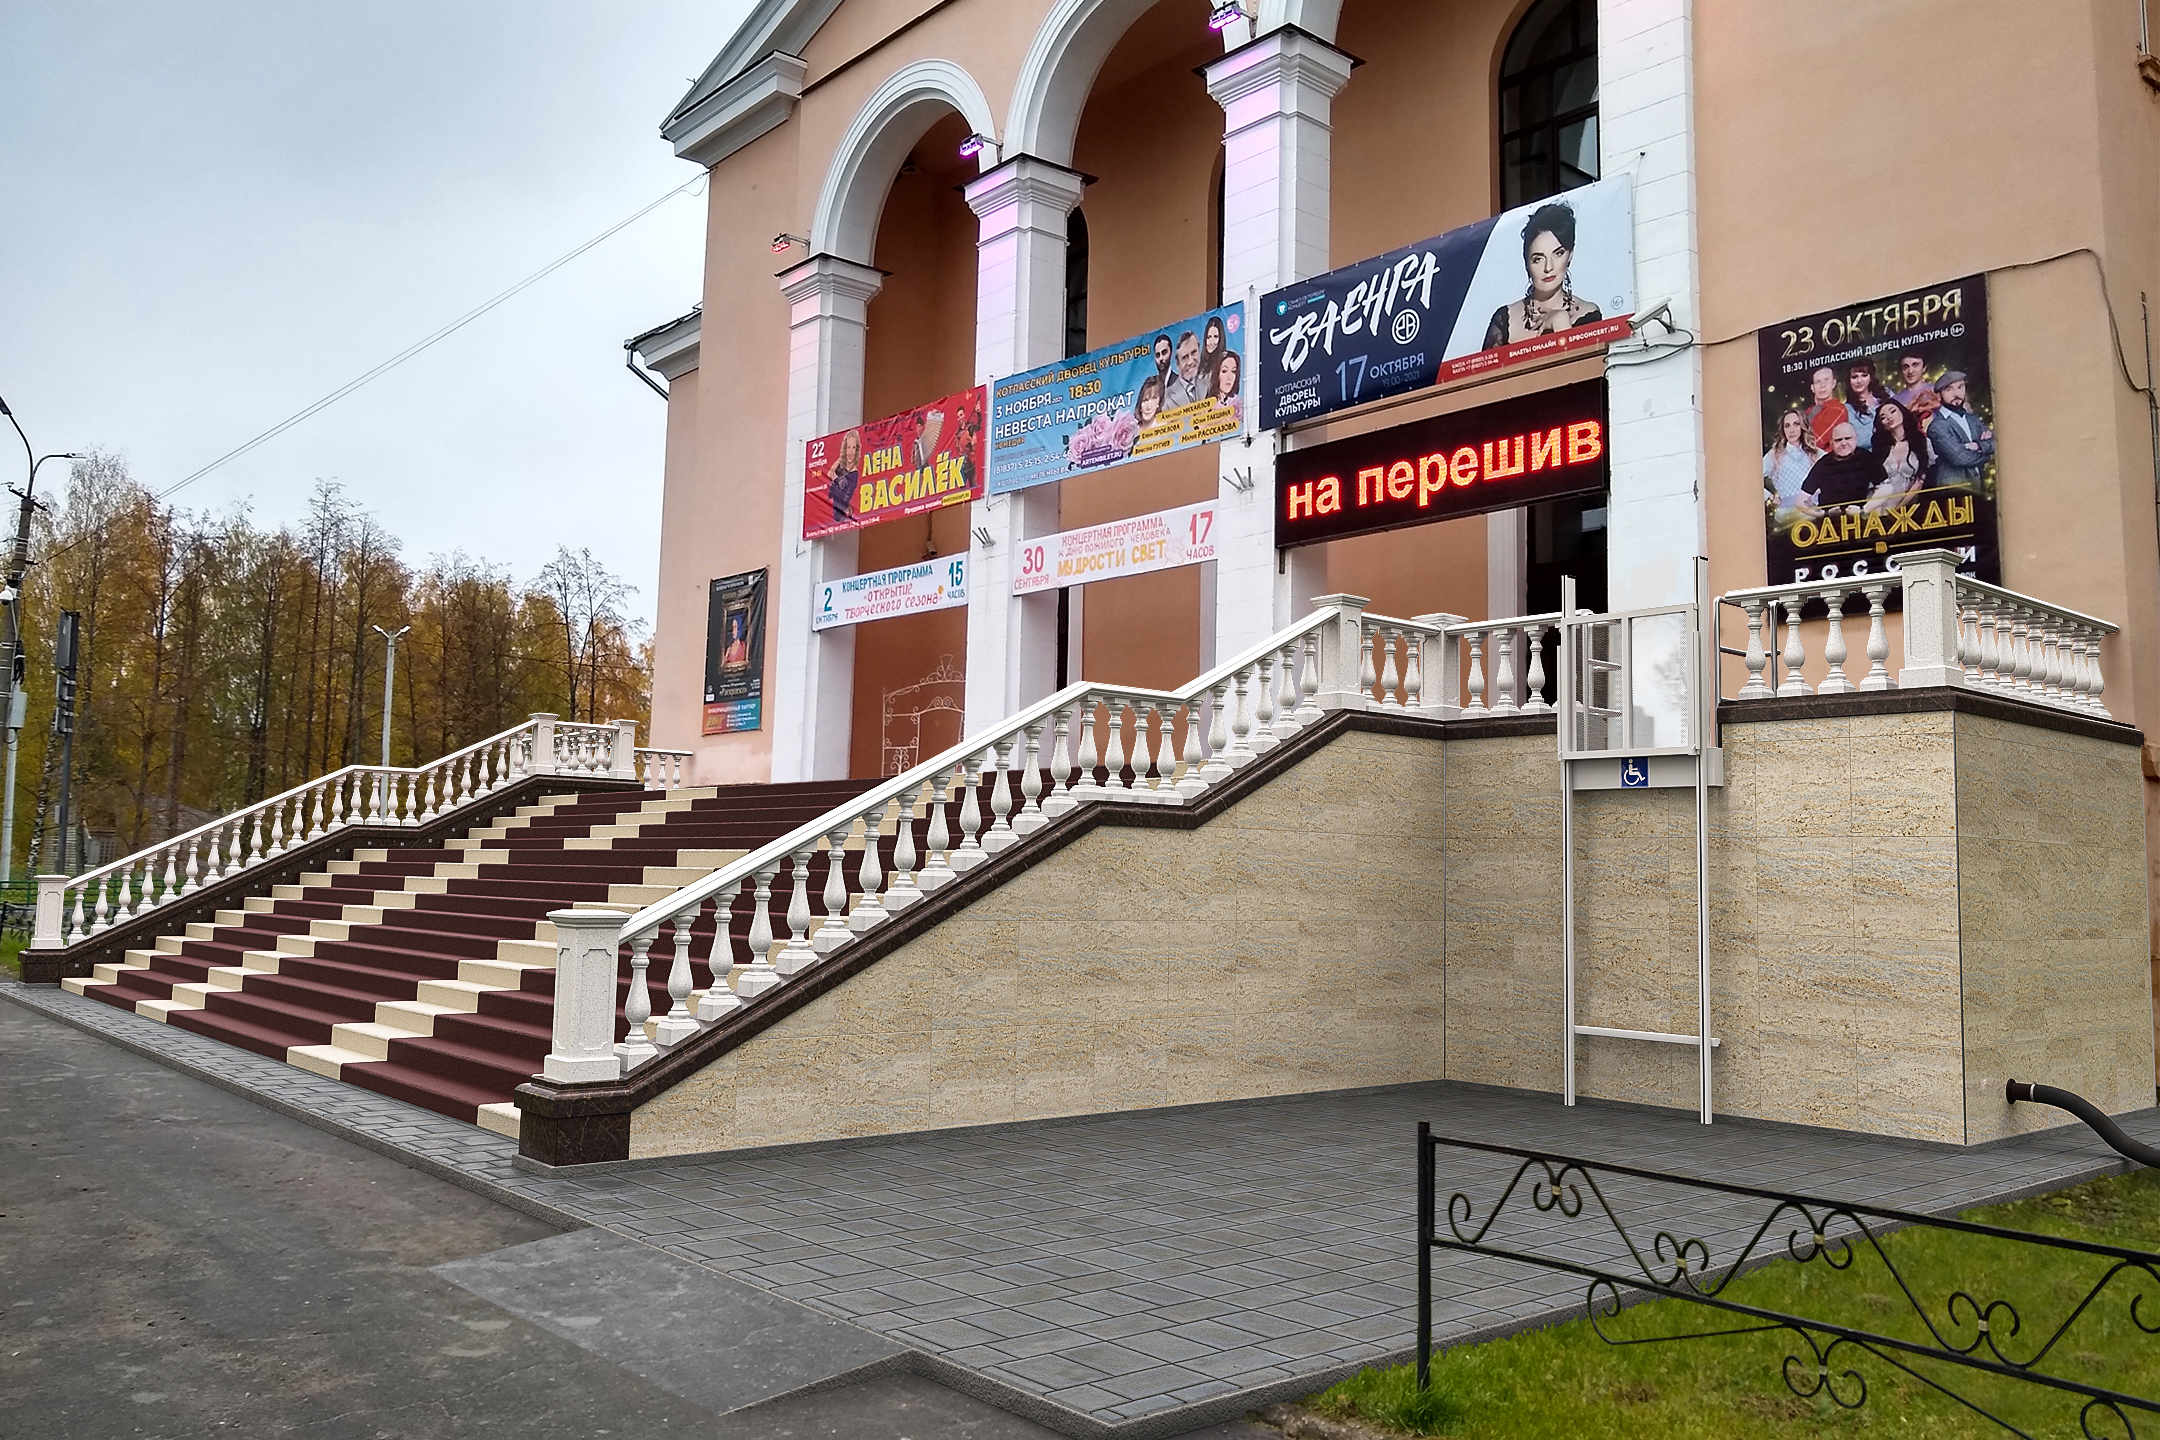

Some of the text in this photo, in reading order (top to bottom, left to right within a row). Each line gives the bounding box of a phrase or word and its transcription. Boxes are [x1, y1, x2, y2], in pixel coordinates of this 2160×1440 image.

[1228, 318, 1240, 329] 6+
[1270, 251, 1440, 373] ВАЕНГА
[1781, 288, 1962, 359] 23 ОКТЯБРЯ
[1568, 325, 1619, 343] SPBCONCERT.RU
[1509, 340, 1557, 358] БИЛЕТЫ ОНЛАЙН
[1782, 362, 1803, 374] 18:30
[1809, 346, 1862, 368] КОТЛАССКИЙ
[1864, 340, 1900, 356] ДВОРЕЦ
[1902, 328, 1949, 346] КУЛЬТУРЫ
[996, 344, 1151, 399] КОТЛАССКИЙ ДВОРЕЦ КУЛЬТУРЫ
[1336, 352, 1424, 401] 17 ОКТЯБРЯ
[1275, 374, 1321, 396] КОТЛАССКИЙ
[1279, 387, 1316, 407] ДВОРЕЦ
[996, 406, 1003, 419] 3
[1005, 392, 1052, 416] НОЯБРЯ
[1068, 380, 1102, 400] 18:30
[1183, 401, 1211, 415] МИХАЙЛОВ
[1275, 397, 1321, 419] КУЛЬТУРЫ
[995, 391, 1135, 440] НЕВЕСТА НАПРОКАТ
[1207, 409, 1231, 421] ТАКШИНА
[1154, 424, 1180, 437] ПРОКЛОВА
[1198, 422, 1237, 438] РАССКАЗОВА
[812, 442, 825, 459] 22
[995, 436, 1026, 450] КОМЕДИЯ
[809, 458, 828, 469] октября
[862, 446, 903, 477] ЛЕНА
[1289, 420, 1602, 520] на перешив
[860, 452, 965, 513] ВАСИЛЁК
[1189, 510, 1214, 545] 17
[1791, 495, 1975, 548] ОДНАЖДЫ
[1058, 549, 1064, 558] К
[1084, 538, 1125, 553] ПОЖИЛОГО
[1131, 528, 1171, 543] ЧЕЛОВЕКА
[1062, 526, 1112, 547] КОНЦЕРТНАЯ
[1023, 545, 1045, 575] 30
[1057, 539, 1167, 577] МУДРОСТИ СВЕТ
[1187, 545, 1215, 560] ЧАСОВ
[1795, 545, 1976, 583] РОССИ
[842, 564, 933, 593] КОНЦЕРТНАЯ ПРОГРАММА
[949, 561, 964, 588] 15
[1014, 574, 1050, 590] СЕНТЯБРЯ
[824, 587, 833, 612] 2
[947, 590, 965, 600] ЧАСОВ
[816, 613, 839, 625] ОКТЯБРЯ
